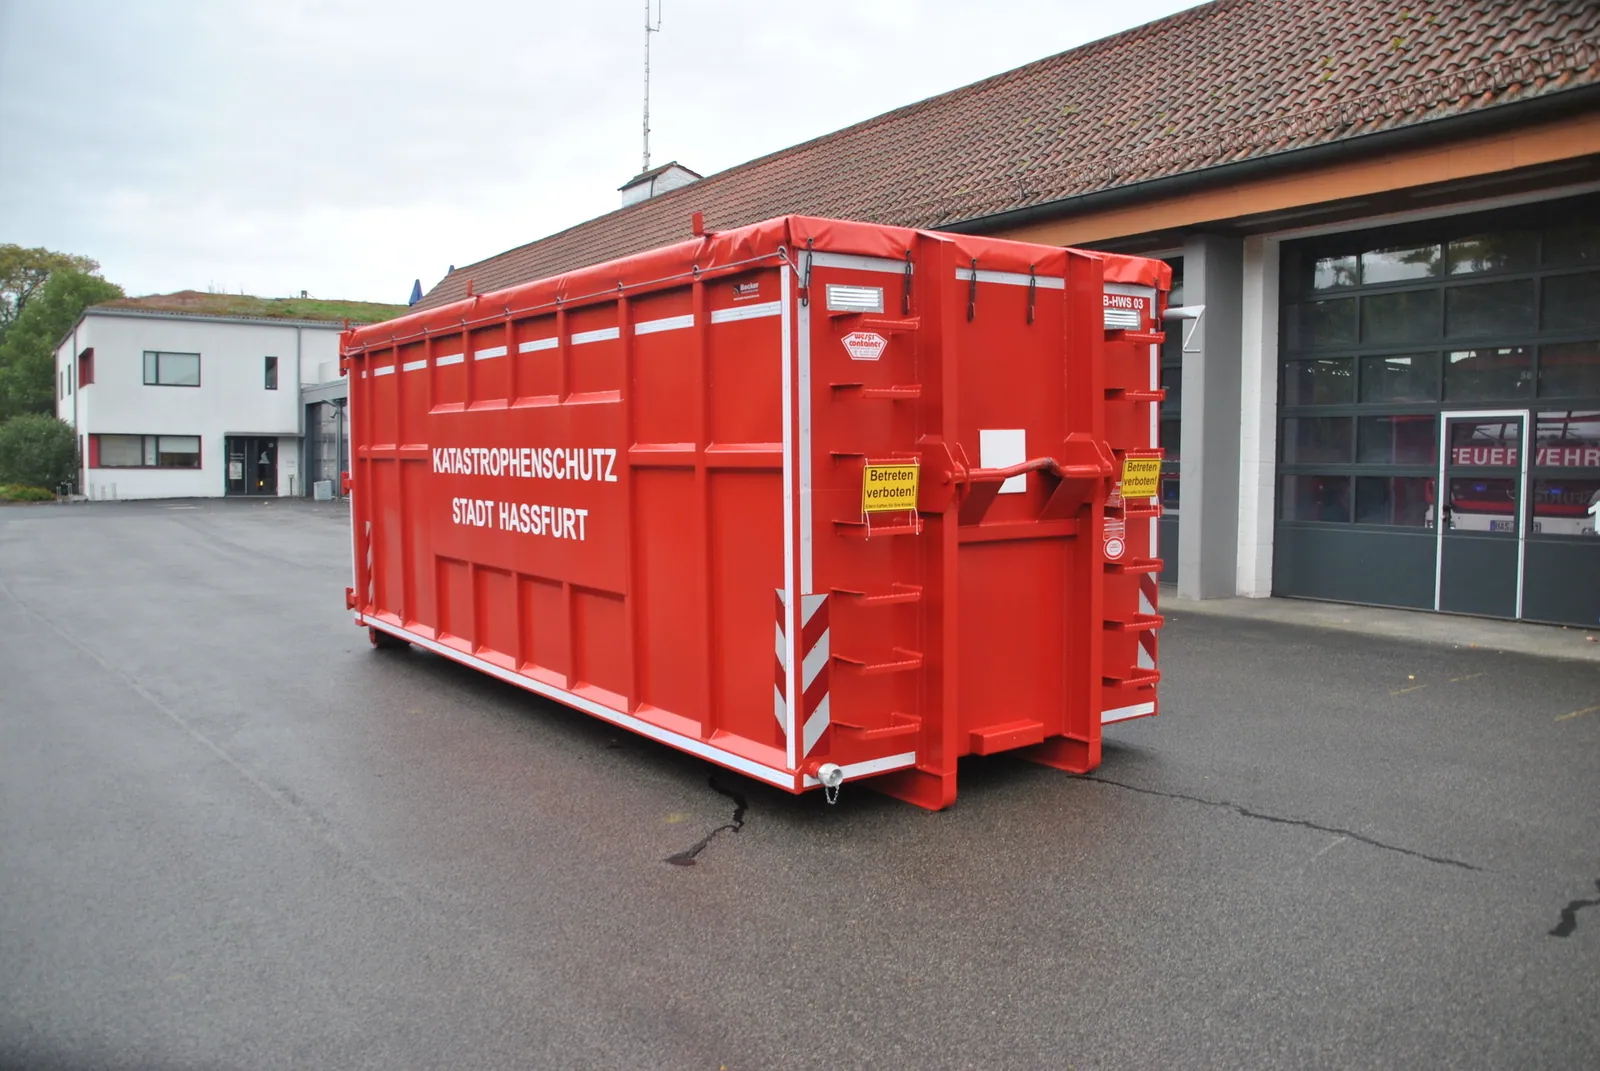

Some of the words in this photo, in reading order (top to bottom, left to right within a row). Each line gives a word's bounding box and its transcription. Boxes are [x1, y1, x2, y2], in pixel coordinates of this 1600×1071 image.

[1133, 298, 1144, 309] 03
[849, 340, 881, 348] container
[433, 447, 617, 482] KATASTROPHENSCHUTZ
[1127, 462, 1157, 472] Betreten
[870, 469, 914, 481] Betreten
[1124, 476, 1157, 486] verboten!
[866, 485, 915, 498] verboten!
[452, 497, 494, 529] STADT
[499, 501, 588, 541] HASSFURT
